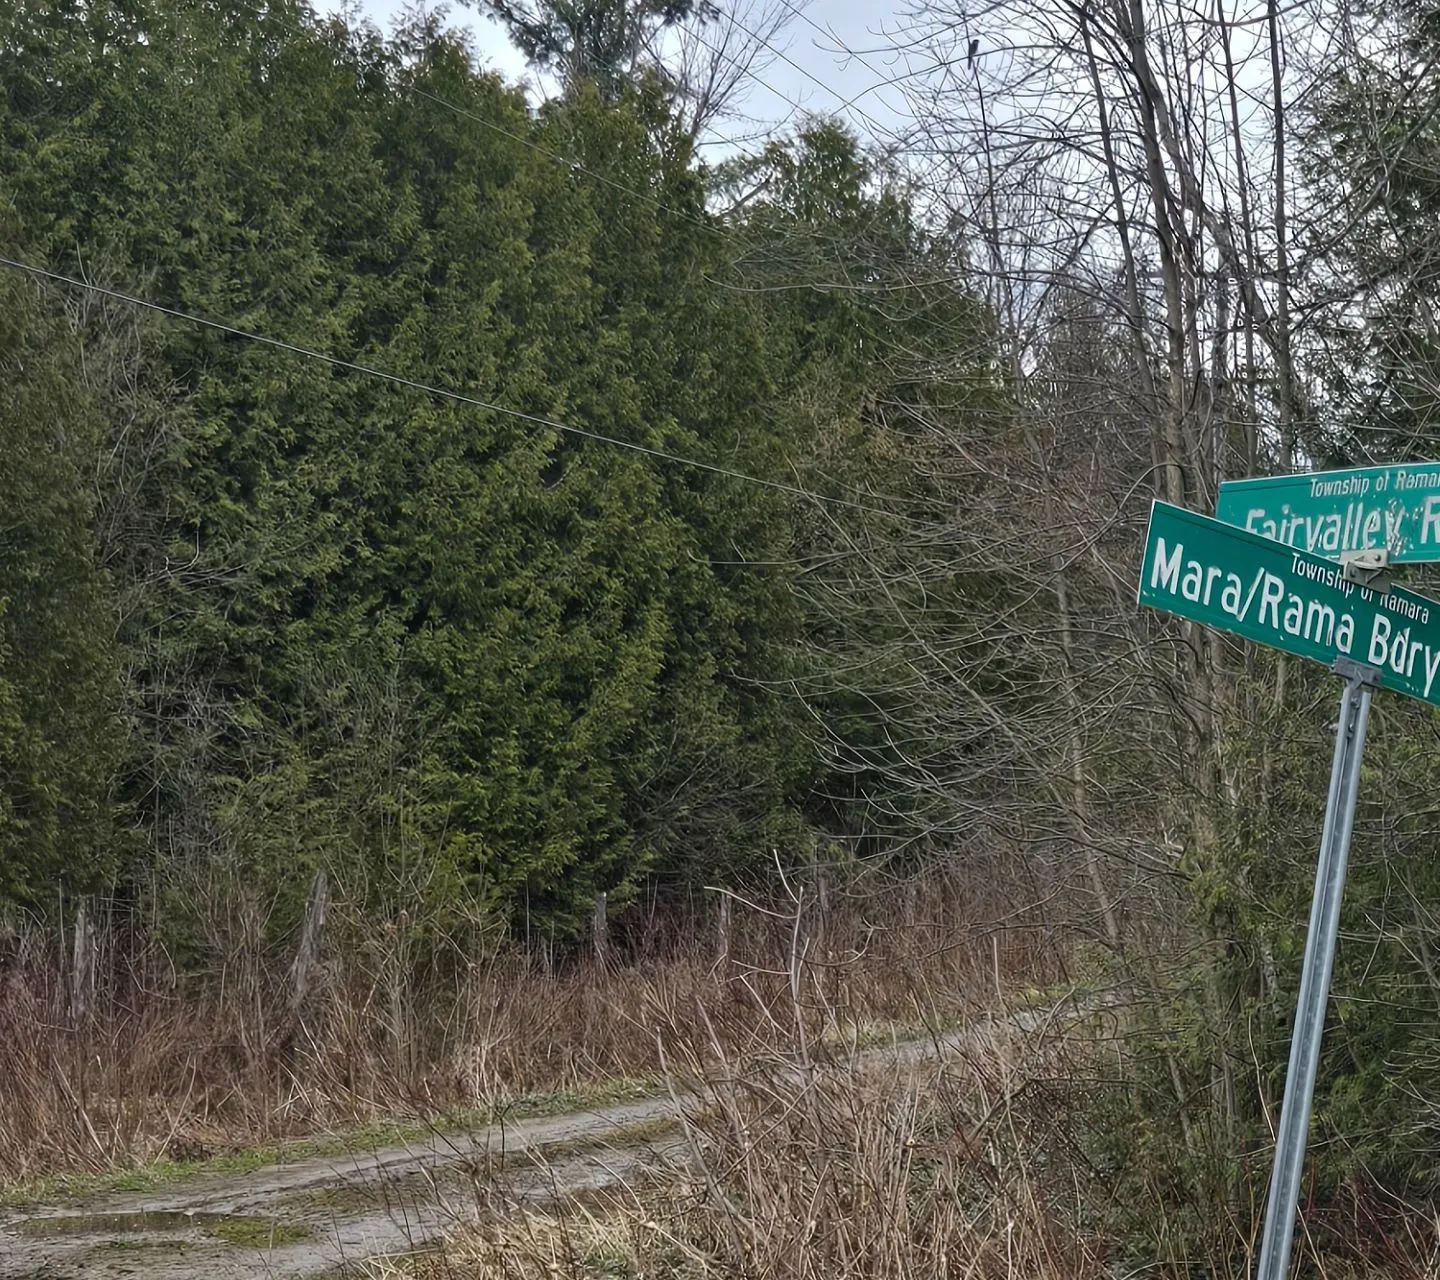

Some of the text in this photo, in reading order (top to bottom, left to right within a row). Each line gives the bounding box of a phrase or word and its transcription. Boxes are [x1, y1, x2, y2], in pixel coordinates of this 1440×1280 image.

[1310, 477, 1369, 498] Township
[1375, 474, 1389, 491] of
[1151, 537, 1355, 654] Mara/Rama
[1292, 553, 1354, 598] Township
